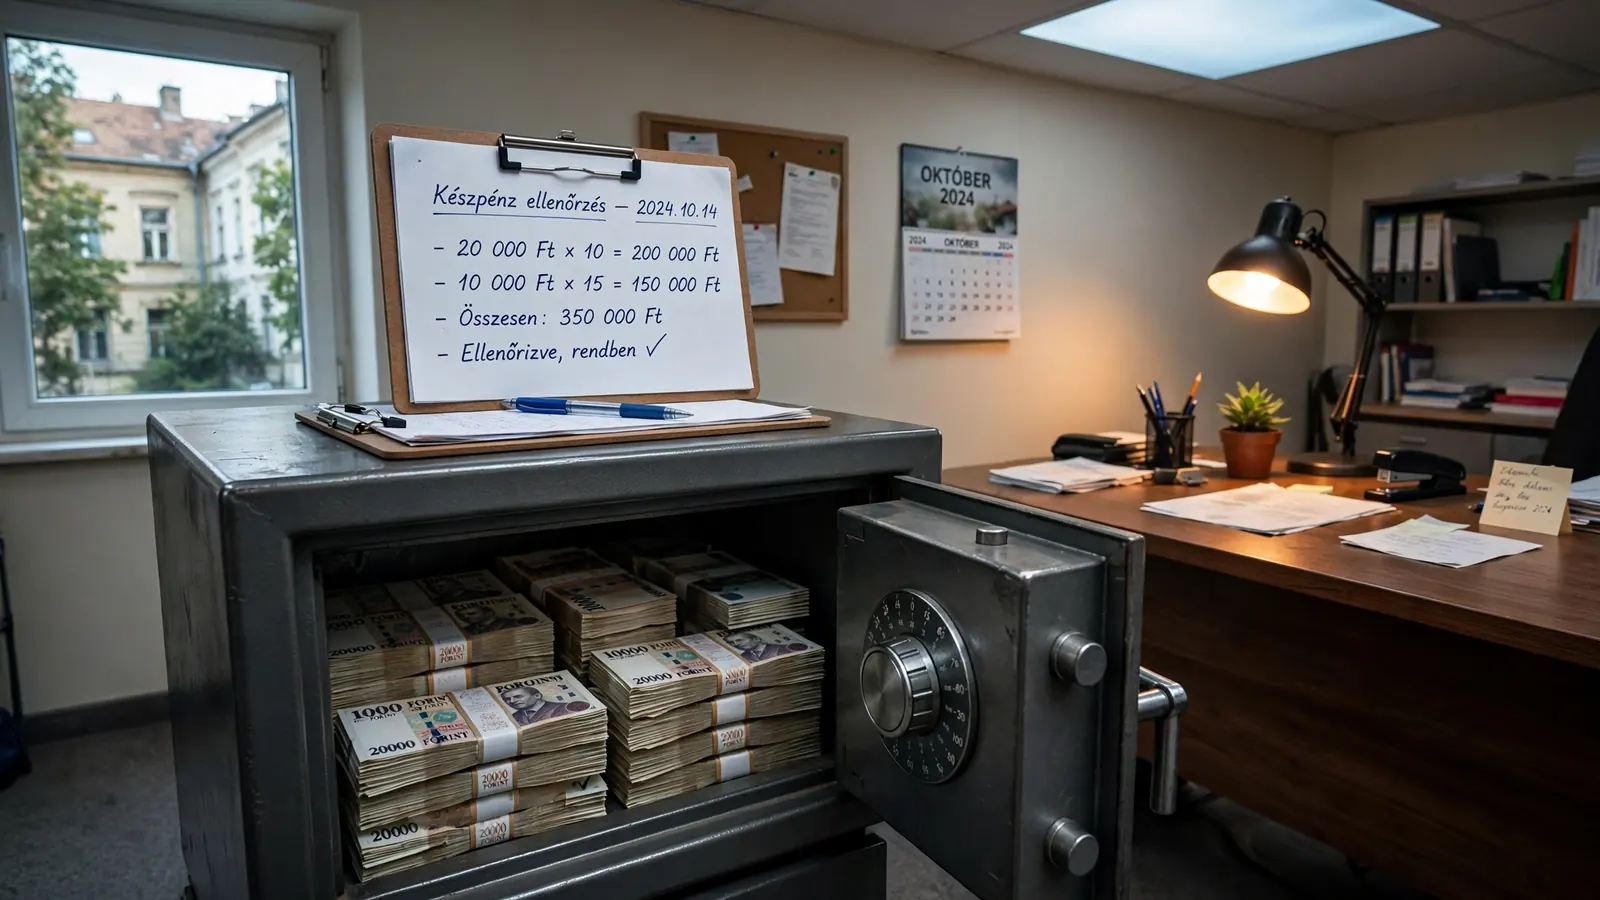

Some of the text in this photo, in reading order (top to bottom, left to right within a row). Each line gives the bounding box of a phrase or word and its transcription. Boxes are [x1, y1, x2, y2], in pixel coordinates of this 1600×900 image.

[921, 165, 991, 190] OKTÓBER
[432, 184, 517, 214] Készpénz
[526, 190, 606, 213] ellenőrzés
[636, 199, 717, 220] 2024.10.14
[940, 188, 975, 206] 2024
[456, 238, 482, 257] 20
[492, 240, 527, 258] 000
[536, 240, 556, 259] Ft
[584, 242, 604, 260] 10
[632, 244, 661, 261] 200
[668, 246, 697, 262] 000
[703, 246, 720, 263] Ft
[908, 236, 927, 245] 2024
[944, 237, 979, 249] OKTÓBER
[458, 273, 481, 292] 10
[491, 273, 526, 292] 000
[535, 273, 555, 292] Ft
[583, 274, 605, 292] 15
[632, 275, 661, 292] 150
[668, 276, 697, 293] 000
[704, 276, 721, 293] Ft
[459, 303, 546, 327] Összesen:
[559, 308, 595, 326] 350
[603, 308, 636, 325] 000
[644, 307, 663, 325] Ft
[461, 341, 563, 364] Ellenőrizve,
[571, 339, 637, 359] rendben
[603, 645, 649, 659] 10000
[633, 672, 673, 685] 20000
[351, 702, 403, 720] 1000
[407, 694, 450, 708] FORIN
[369, 731, 469, 757] 20000 FORINT
[370, 822, 419, 842] 20000
